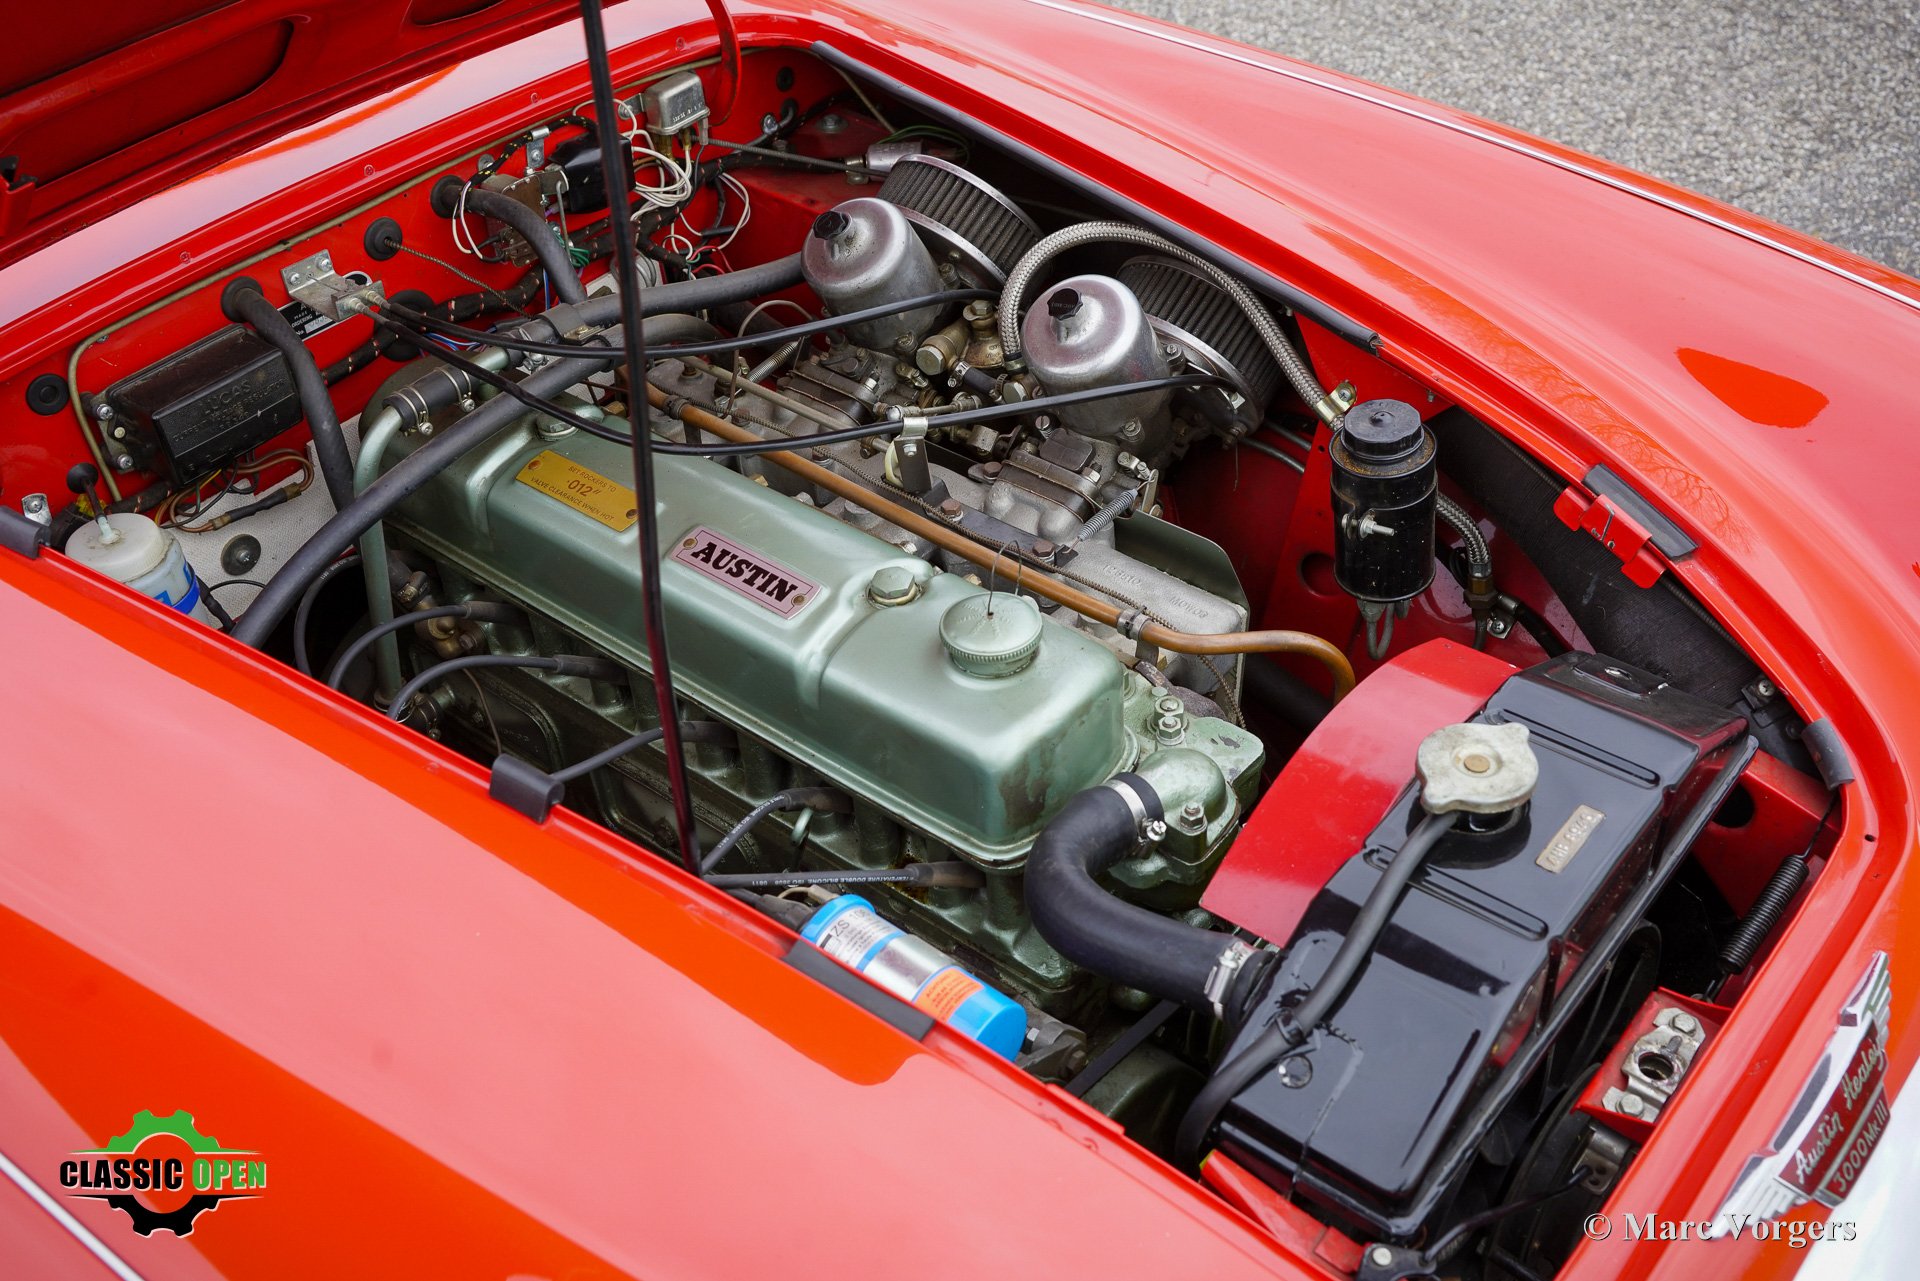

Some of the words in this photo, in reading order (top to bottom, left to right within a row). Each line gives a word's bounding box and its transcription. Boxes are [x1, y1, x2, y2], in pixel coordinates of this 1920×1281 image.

[200, 379, 251, 414] LUCAS
[531, 476, 549, 489] VALVE
[549, 485, 582, 506] CLEARANCE
[582, 501, 600, 516] WHEN
[600, 511, 615, 522] HOT
[568, 466, 580, 475] SET
[580, 469, 607, 489] ROCKERS
[607, 484, 617, 493] TO
[691, 541, 799, 602] AUSTIN
[830, 919, 850, 937] ZS
[1795, 1111, 1844, 1185] Austin
[1841, 1038, 1885, 1111] Healey
